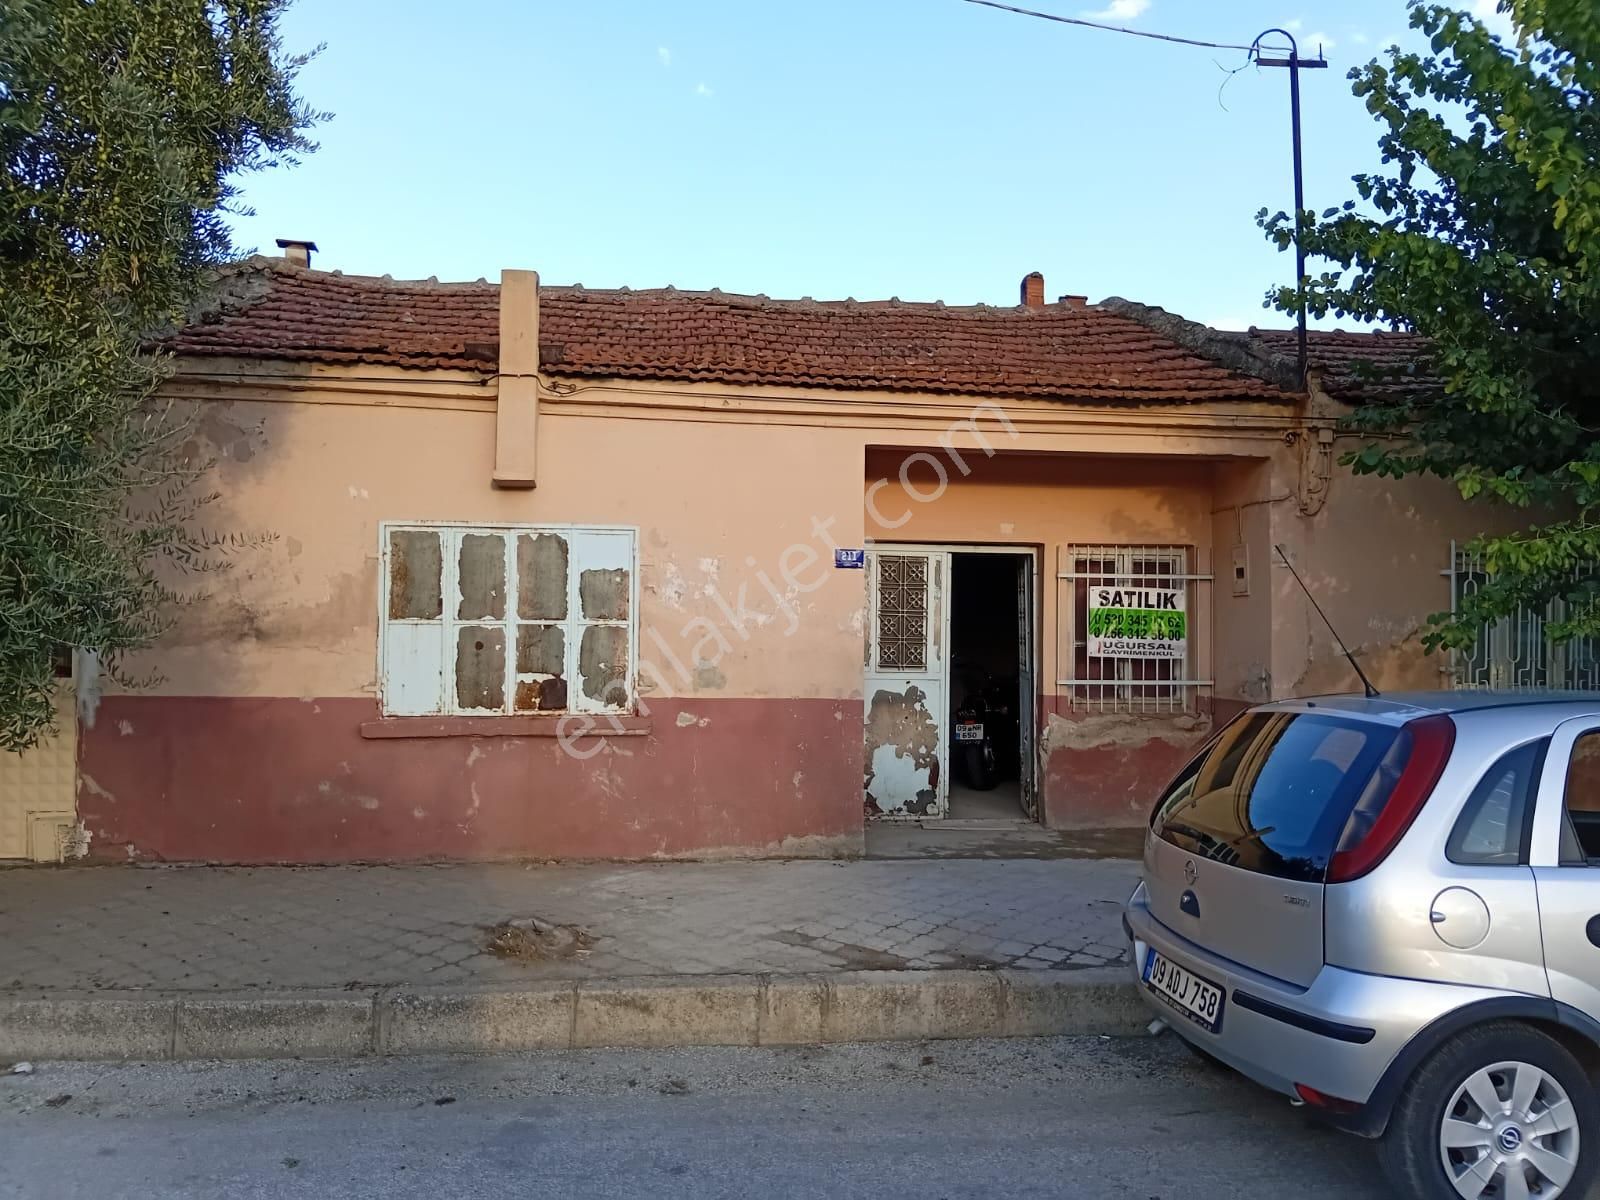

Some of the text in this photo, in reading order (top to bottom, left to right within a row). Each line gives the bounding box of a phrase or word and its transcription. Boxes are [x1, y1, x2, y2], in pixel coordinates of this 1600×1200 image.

[1098, 589, 1177, 610] SATILIK
[1127, 614, 1148, 628] 345
[1168, 629, 1181, 642] 00
[1103, 640, 1175, 650] UĞURSAL
[1152, 957, 1166, 984] 09
[1165, 967, 1190, 1000] ADJ
[1190, 981, 1218, 1018] 758
